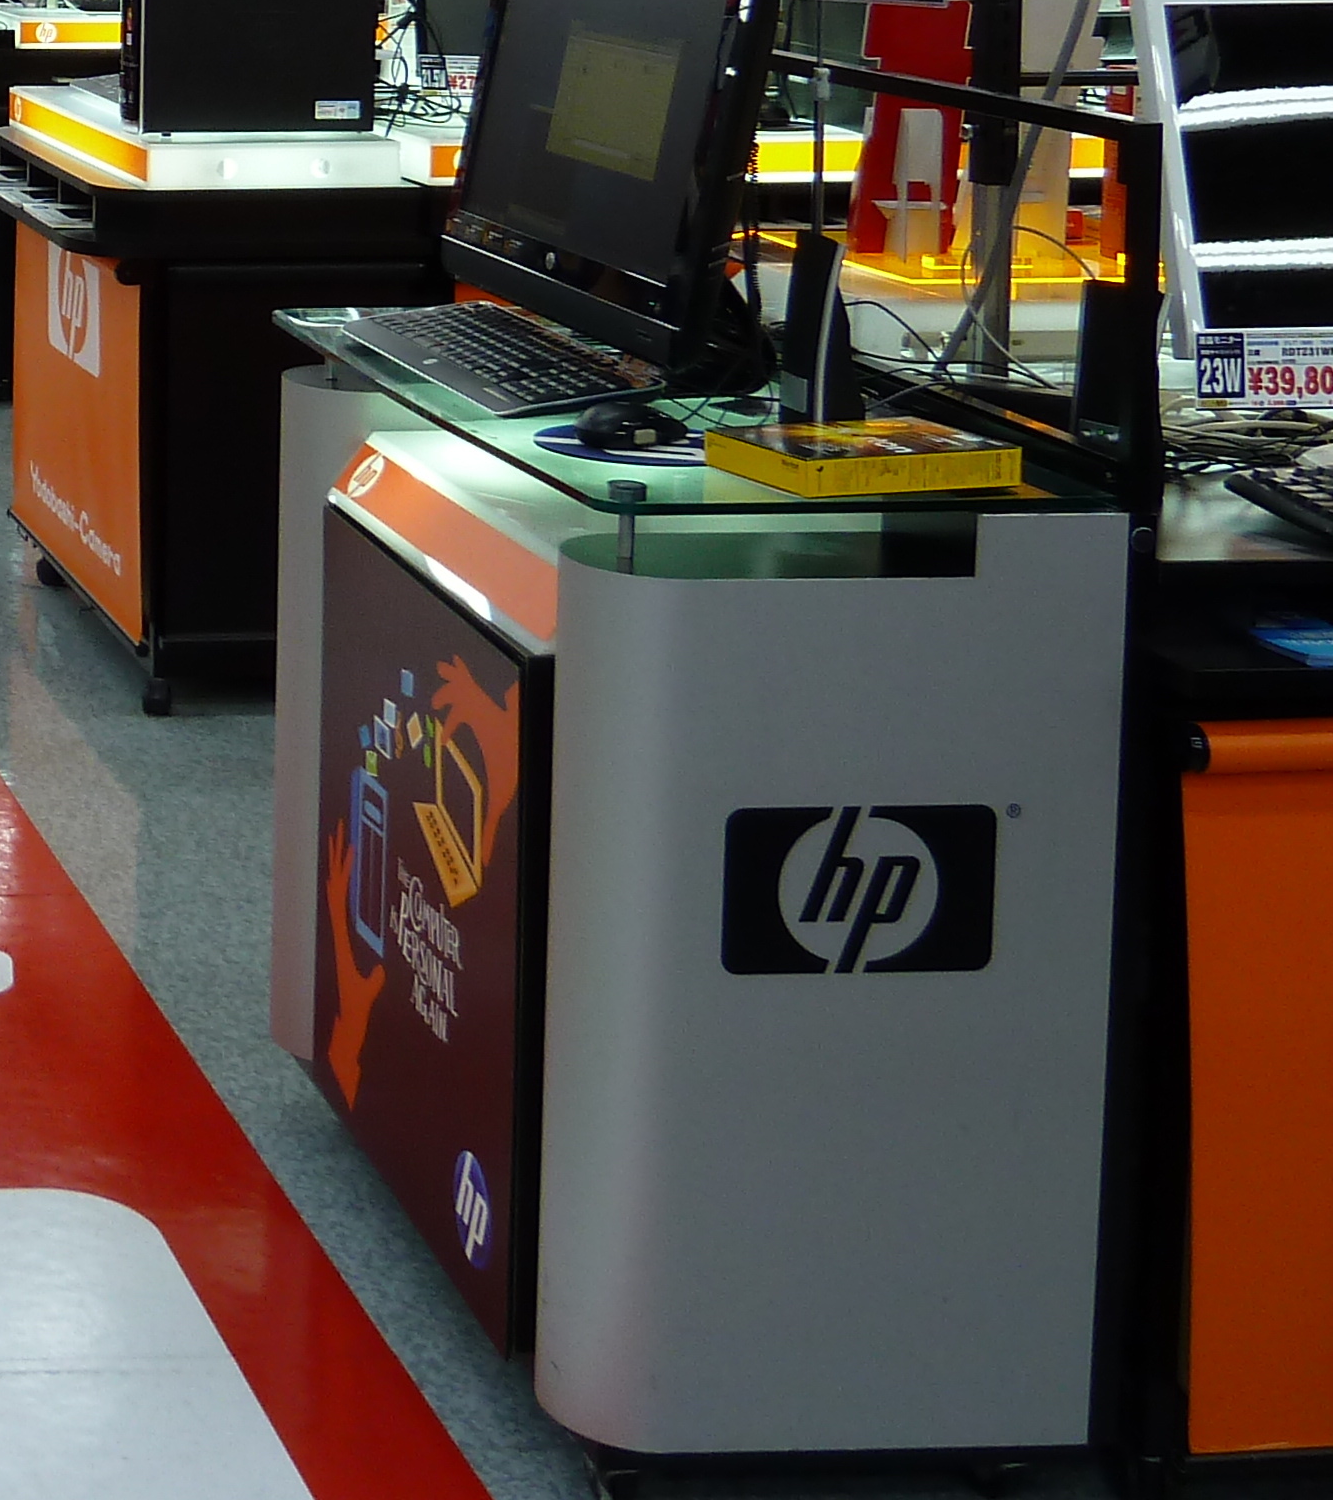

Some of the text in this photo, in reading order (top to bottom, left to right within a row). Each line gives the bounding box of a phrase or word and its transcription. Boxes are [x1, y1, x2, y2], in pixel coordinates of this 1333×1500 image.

[60, 252, 87, 360] hp
[1200, 357, 1242, 394] 23W
[28, 459, 122, 577] Yodobashi-Camera
[799, 805, 921, 973] hp
[453, 1150, 489, 1256] hp
